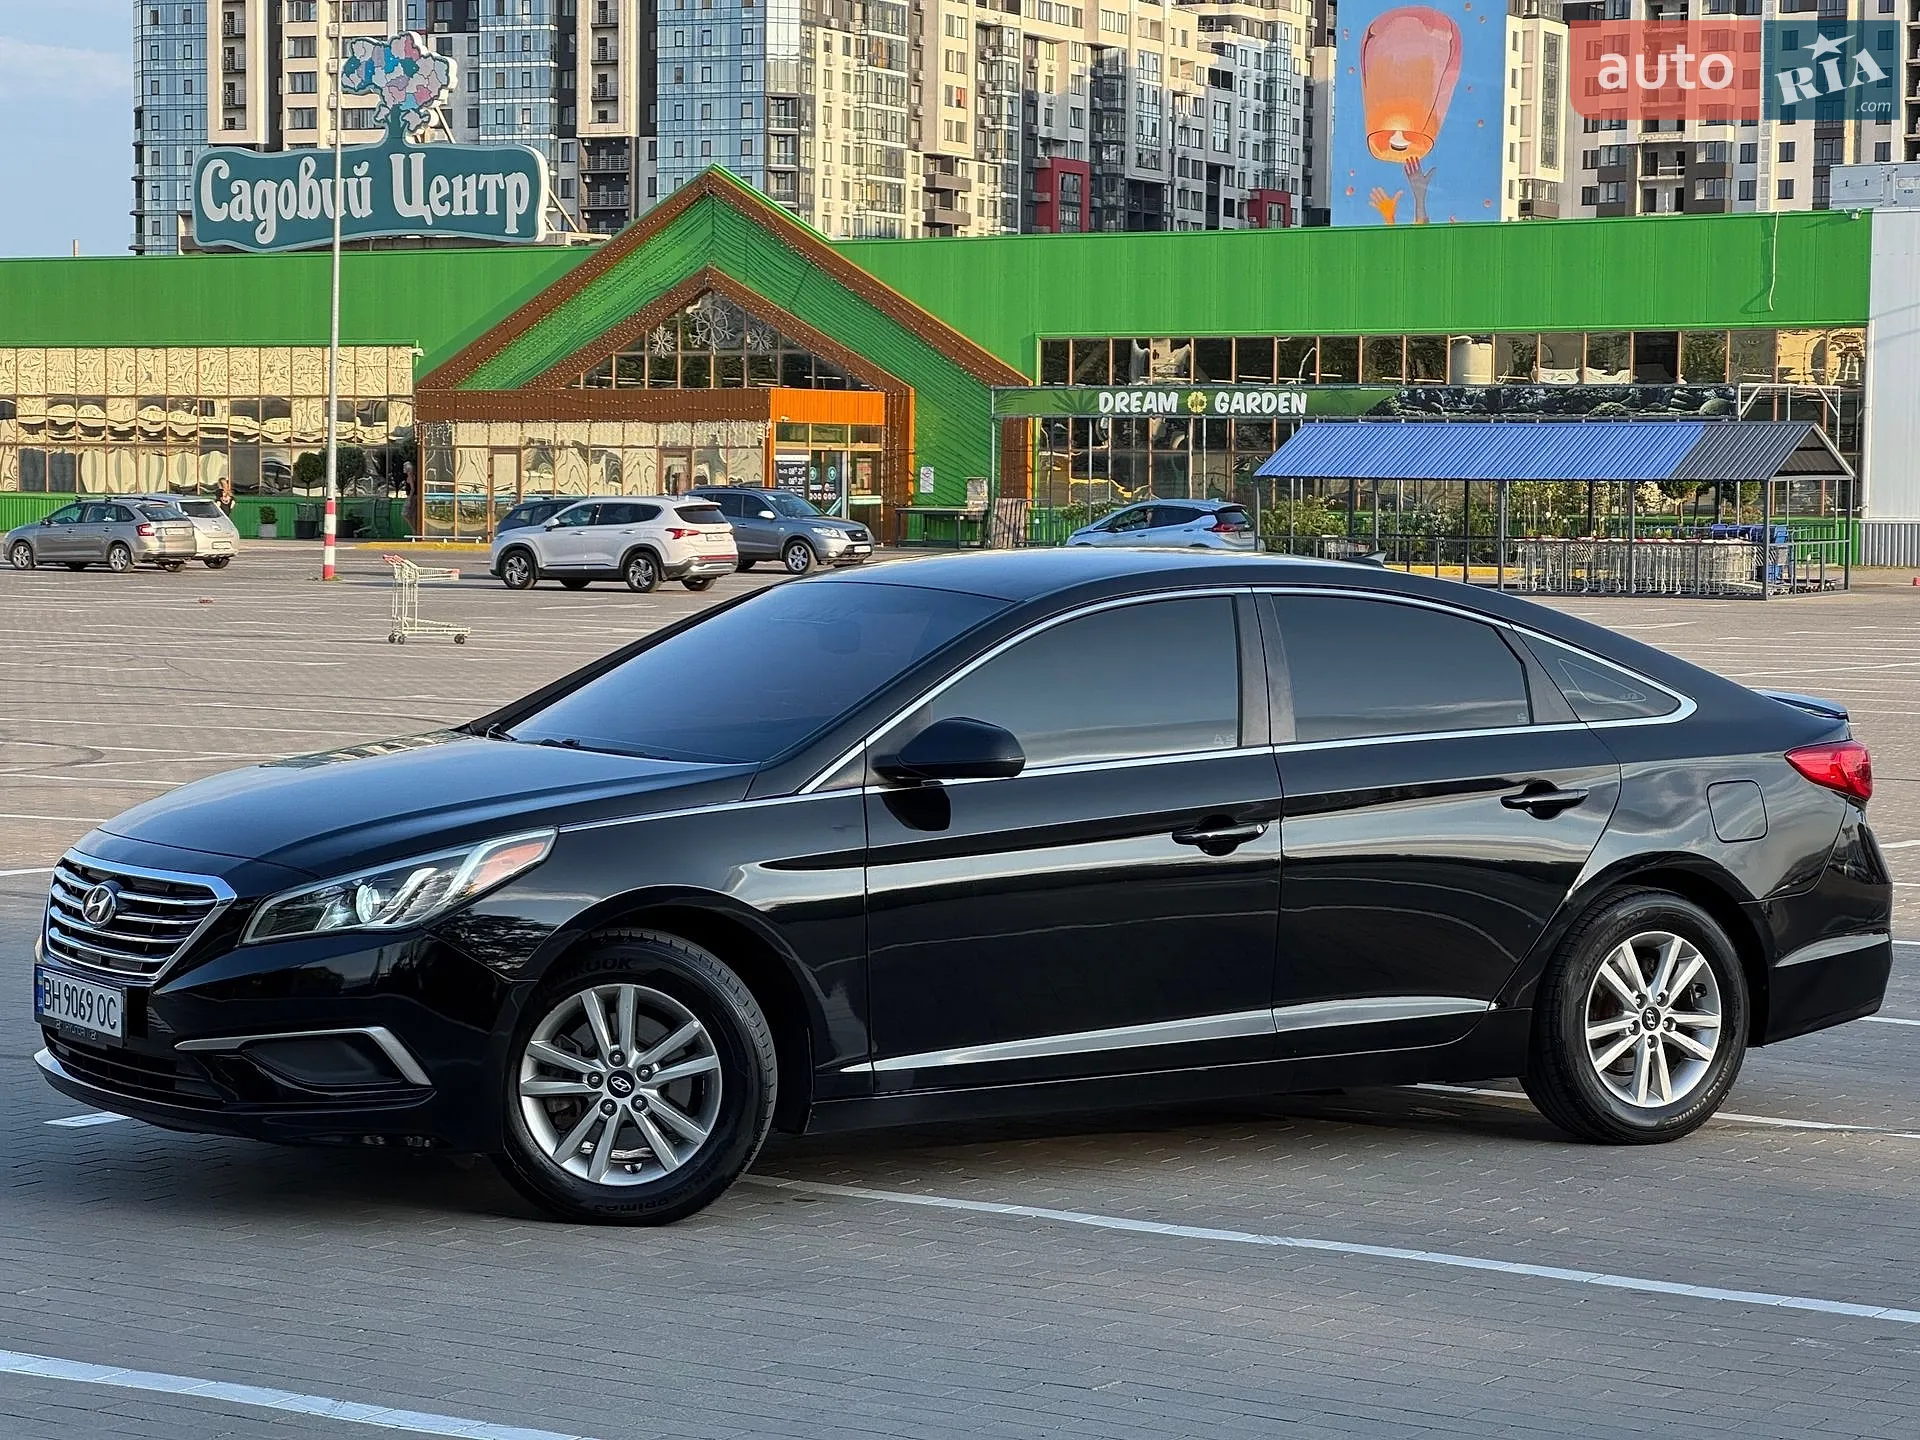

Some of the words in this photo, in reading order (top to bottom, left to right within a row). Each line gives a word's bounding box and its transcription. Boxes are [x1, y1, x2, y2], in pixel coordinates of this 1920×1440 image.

[201, 156, 373, 245] Садовий
[389, 152, 530, 234] Центр
[1099, 391, 1179, 413] DREAM
[1214, 392, 1308, 414] GARDEN
[43, 977, 61, 1014] BH
[63, 983, 94, 1023] 9069
[96, 993, 117, 1030] OC
